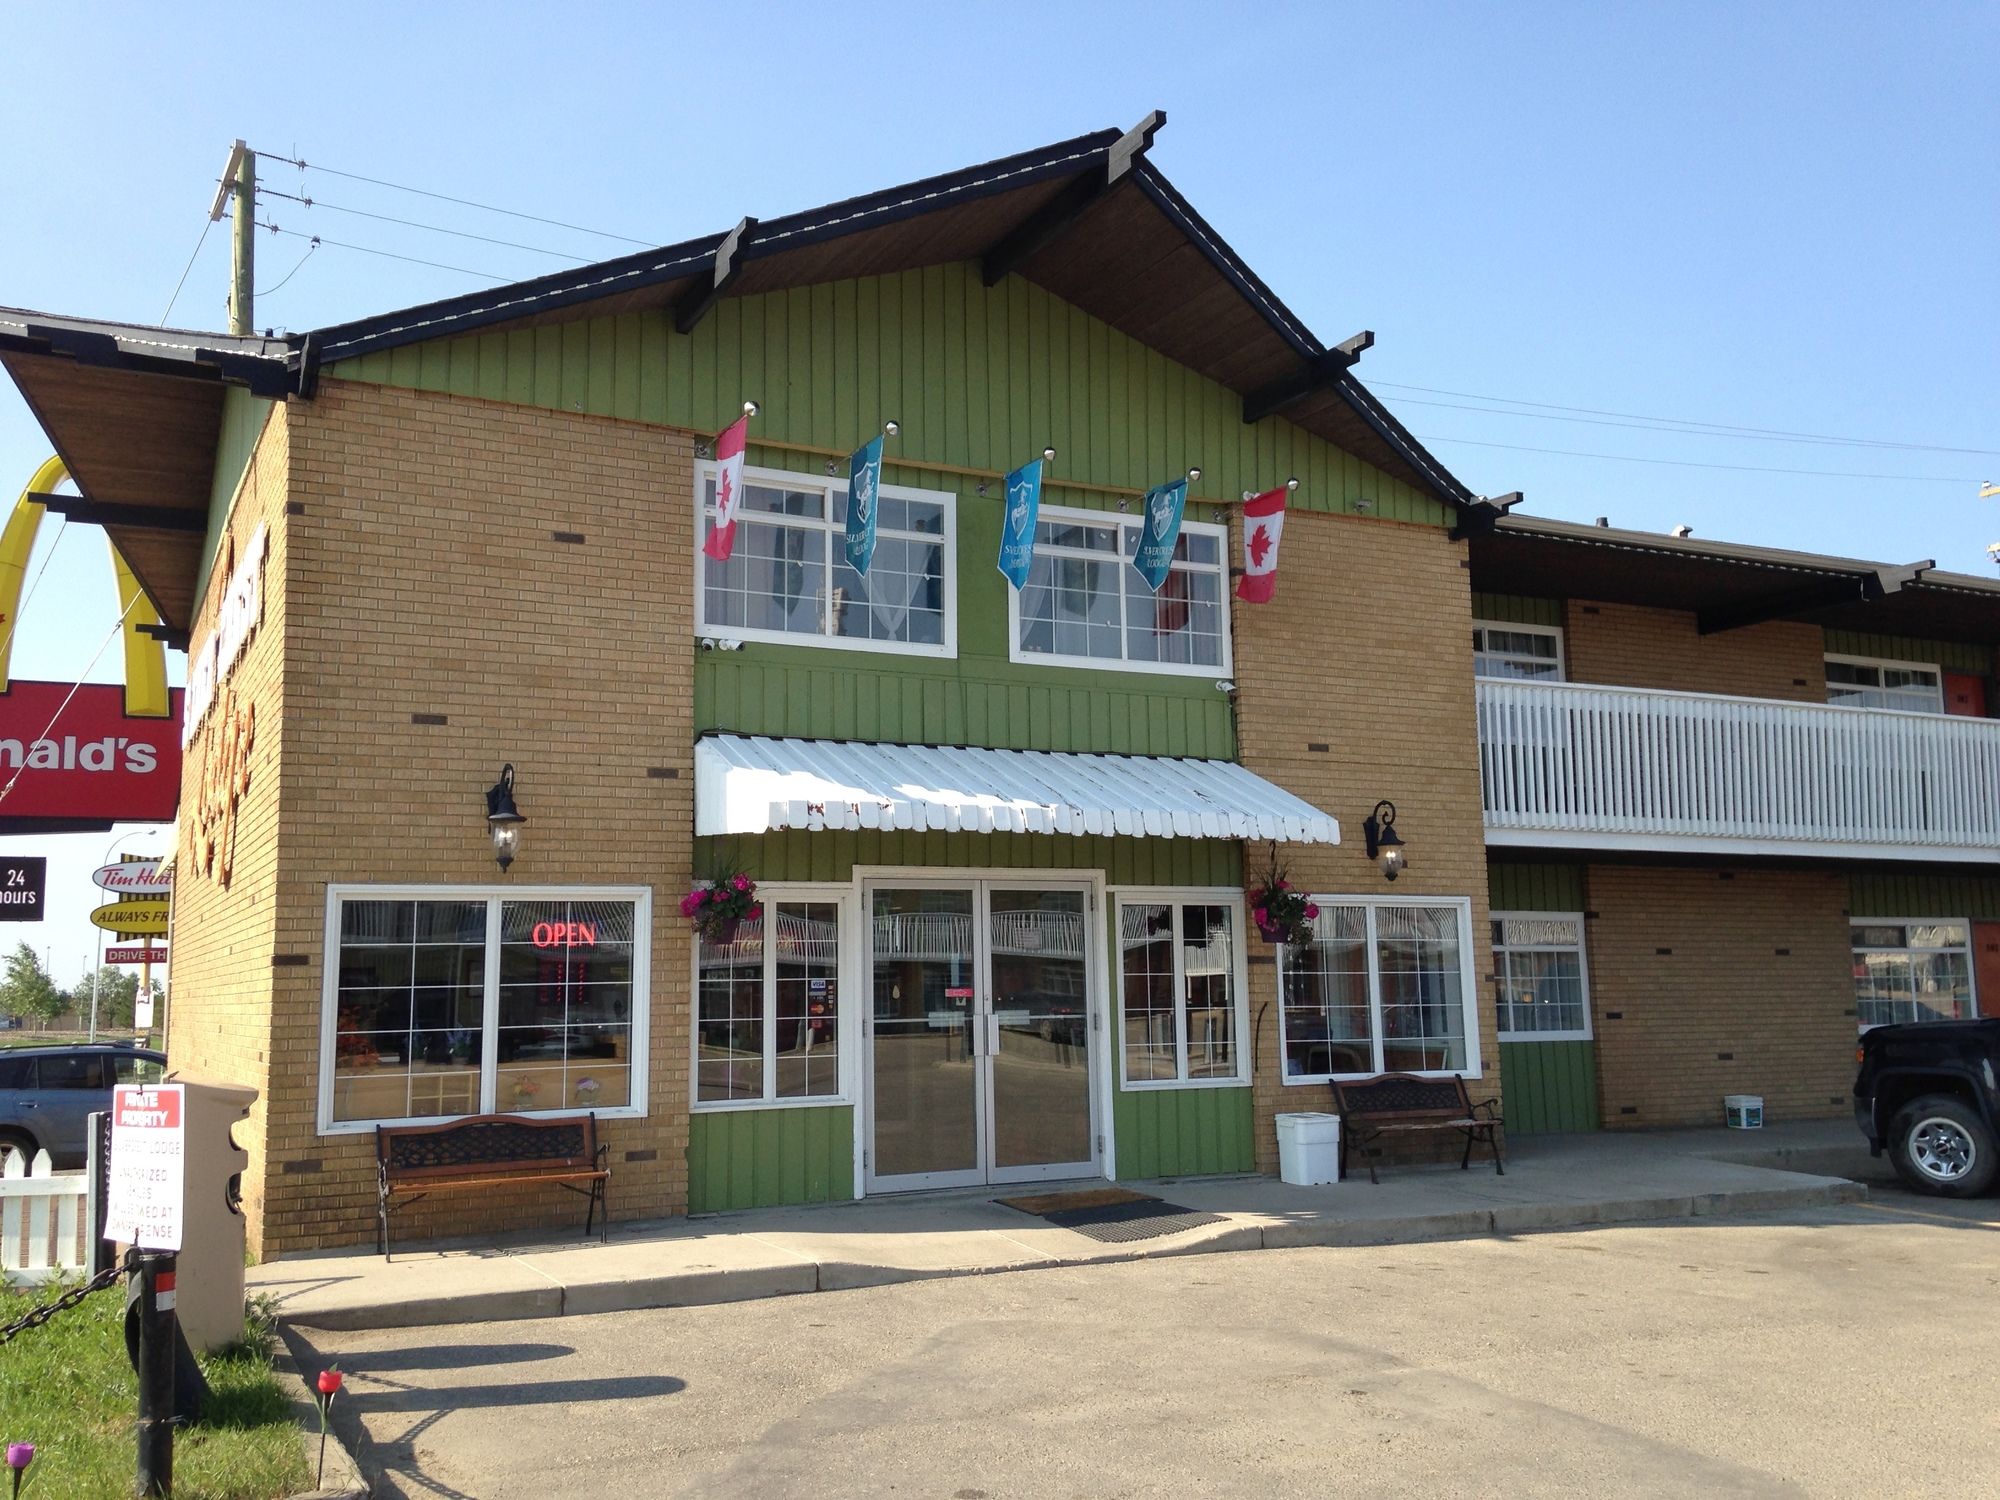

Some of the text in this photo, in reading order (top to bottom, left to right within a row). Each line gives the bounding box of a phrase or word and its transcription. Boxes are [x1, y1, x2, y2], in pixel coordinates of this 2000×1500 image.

[7, 869, 25, 886] 24
[103, 868, 132, 886] Tim
[97, 911, 150, 923] ALWAYS
[533, 922, 595, 947] OPEN
[109, 950, 146, 960] DRIVE
